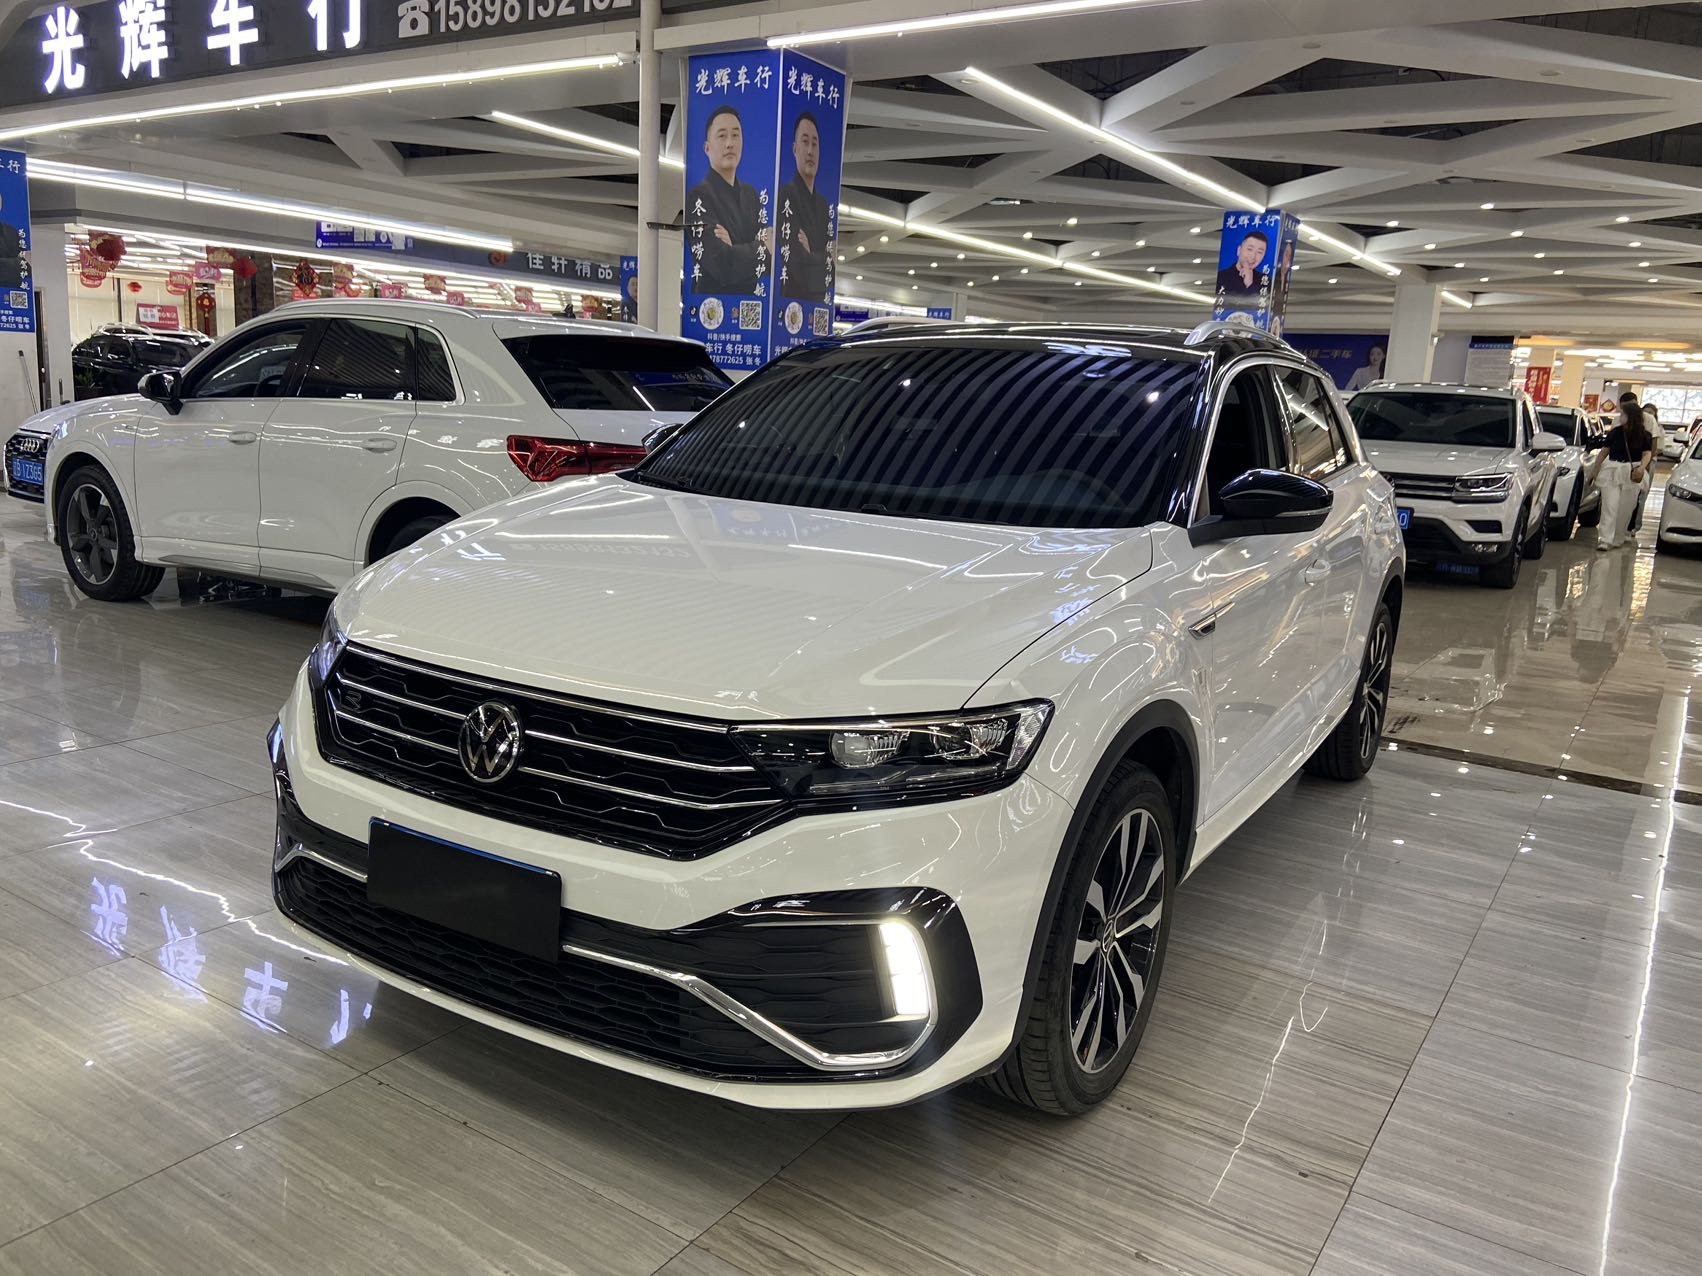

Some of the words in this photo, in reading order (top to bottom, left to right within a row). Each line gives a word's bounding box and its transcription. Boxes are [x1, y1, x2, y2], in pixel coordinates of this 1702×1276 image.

[434, 0, 632, 33] 158981
[41, 0, 361, 94] 光辉车行
[695, 65, 773, 96] 光辉车行
[787, 66, 841, 109] 光辉车行
[1226, 214, 1277, 228] 光辉车行
[753, 189, 770, 298] 为您保驾护航
[726, 343, 761, 355] 冬仔唠车
